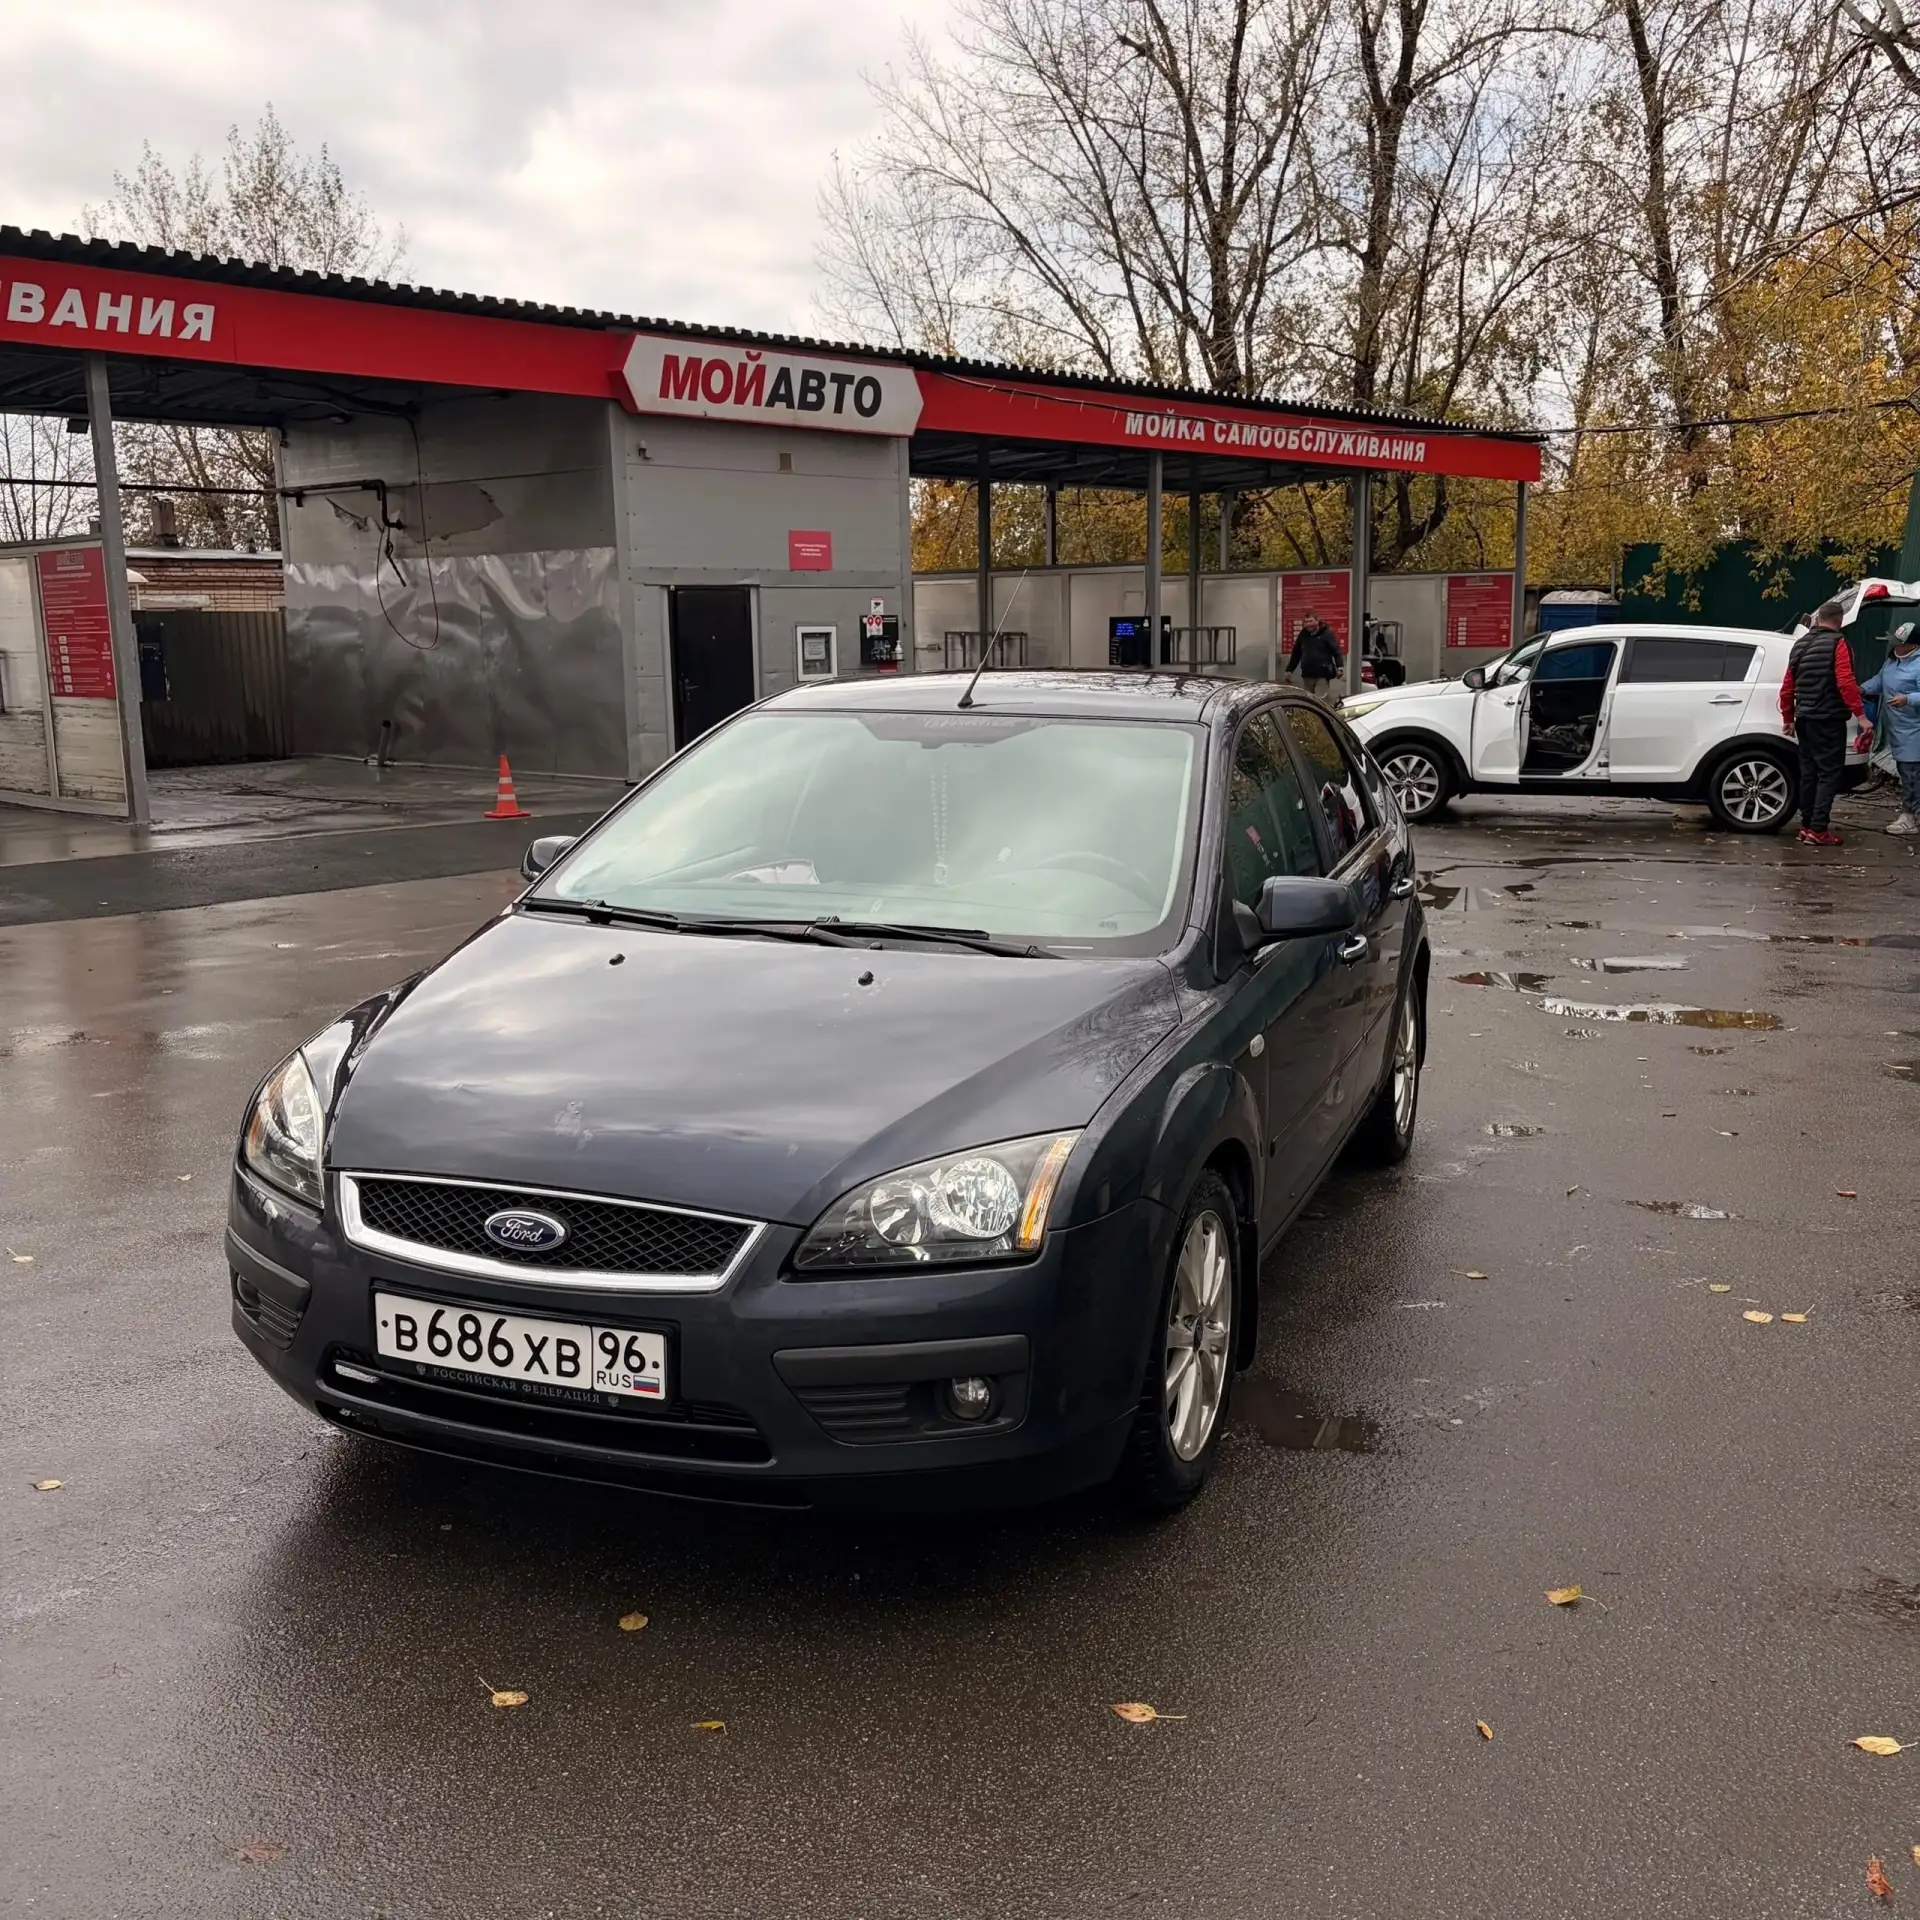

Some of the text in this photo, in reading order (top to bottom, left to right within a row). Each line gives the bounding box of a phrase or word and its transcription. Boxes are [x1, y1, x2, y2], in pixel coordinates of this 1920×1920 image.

[0, 280, 216, 342] ВАНИЯ
[658, 351, 882, 418] МОЙАВТО
[1125, 408, 1426, 463] МОЙКА САМООБСЛУЖИВАНИЯ
[500, 1218, 544, 1242] Ford
[394, 1309, 646, 1378] В686ХВ 96
[432, 1366, 601, 1404] РОССИЙСКАЯ ФЕДЕРАЦИЯ
[596, 1370, 632, 1388] RUS
